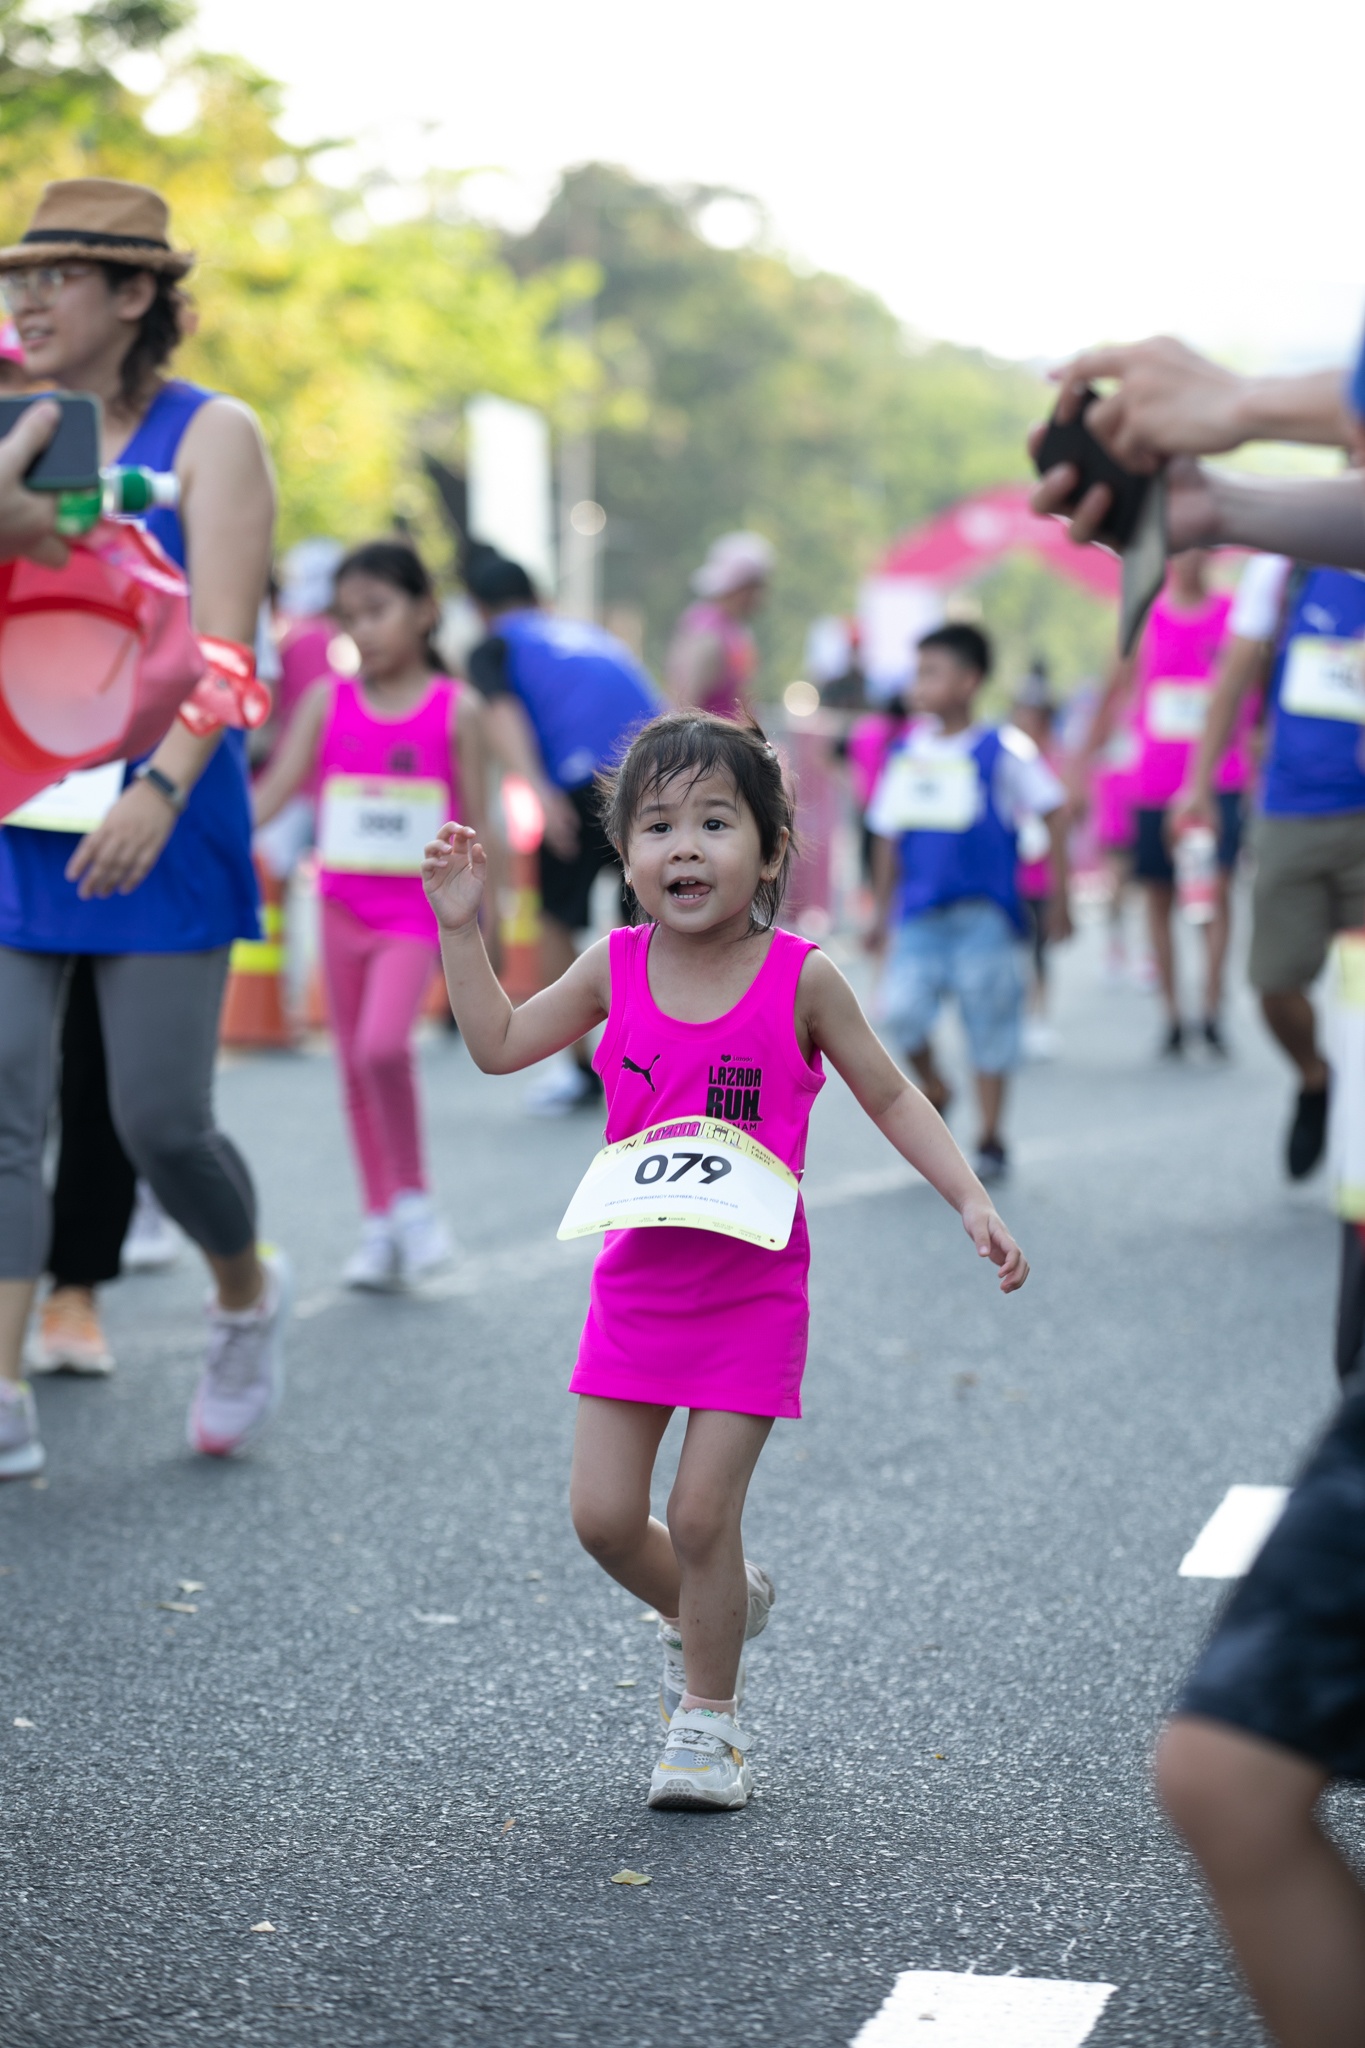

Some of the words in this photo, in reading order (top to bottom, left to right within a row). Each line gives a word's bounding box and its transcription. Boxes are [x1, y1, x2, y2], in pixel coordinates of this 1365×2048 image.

[708, 1065, 762, 1088] LAZADA
[706, 1086, 763, 1122] RUN
[643, 1121, 701, 1144] LAZADA
[700, 1121, 742, 1149] RUN
[634, 1152, 732, 1185] 079
